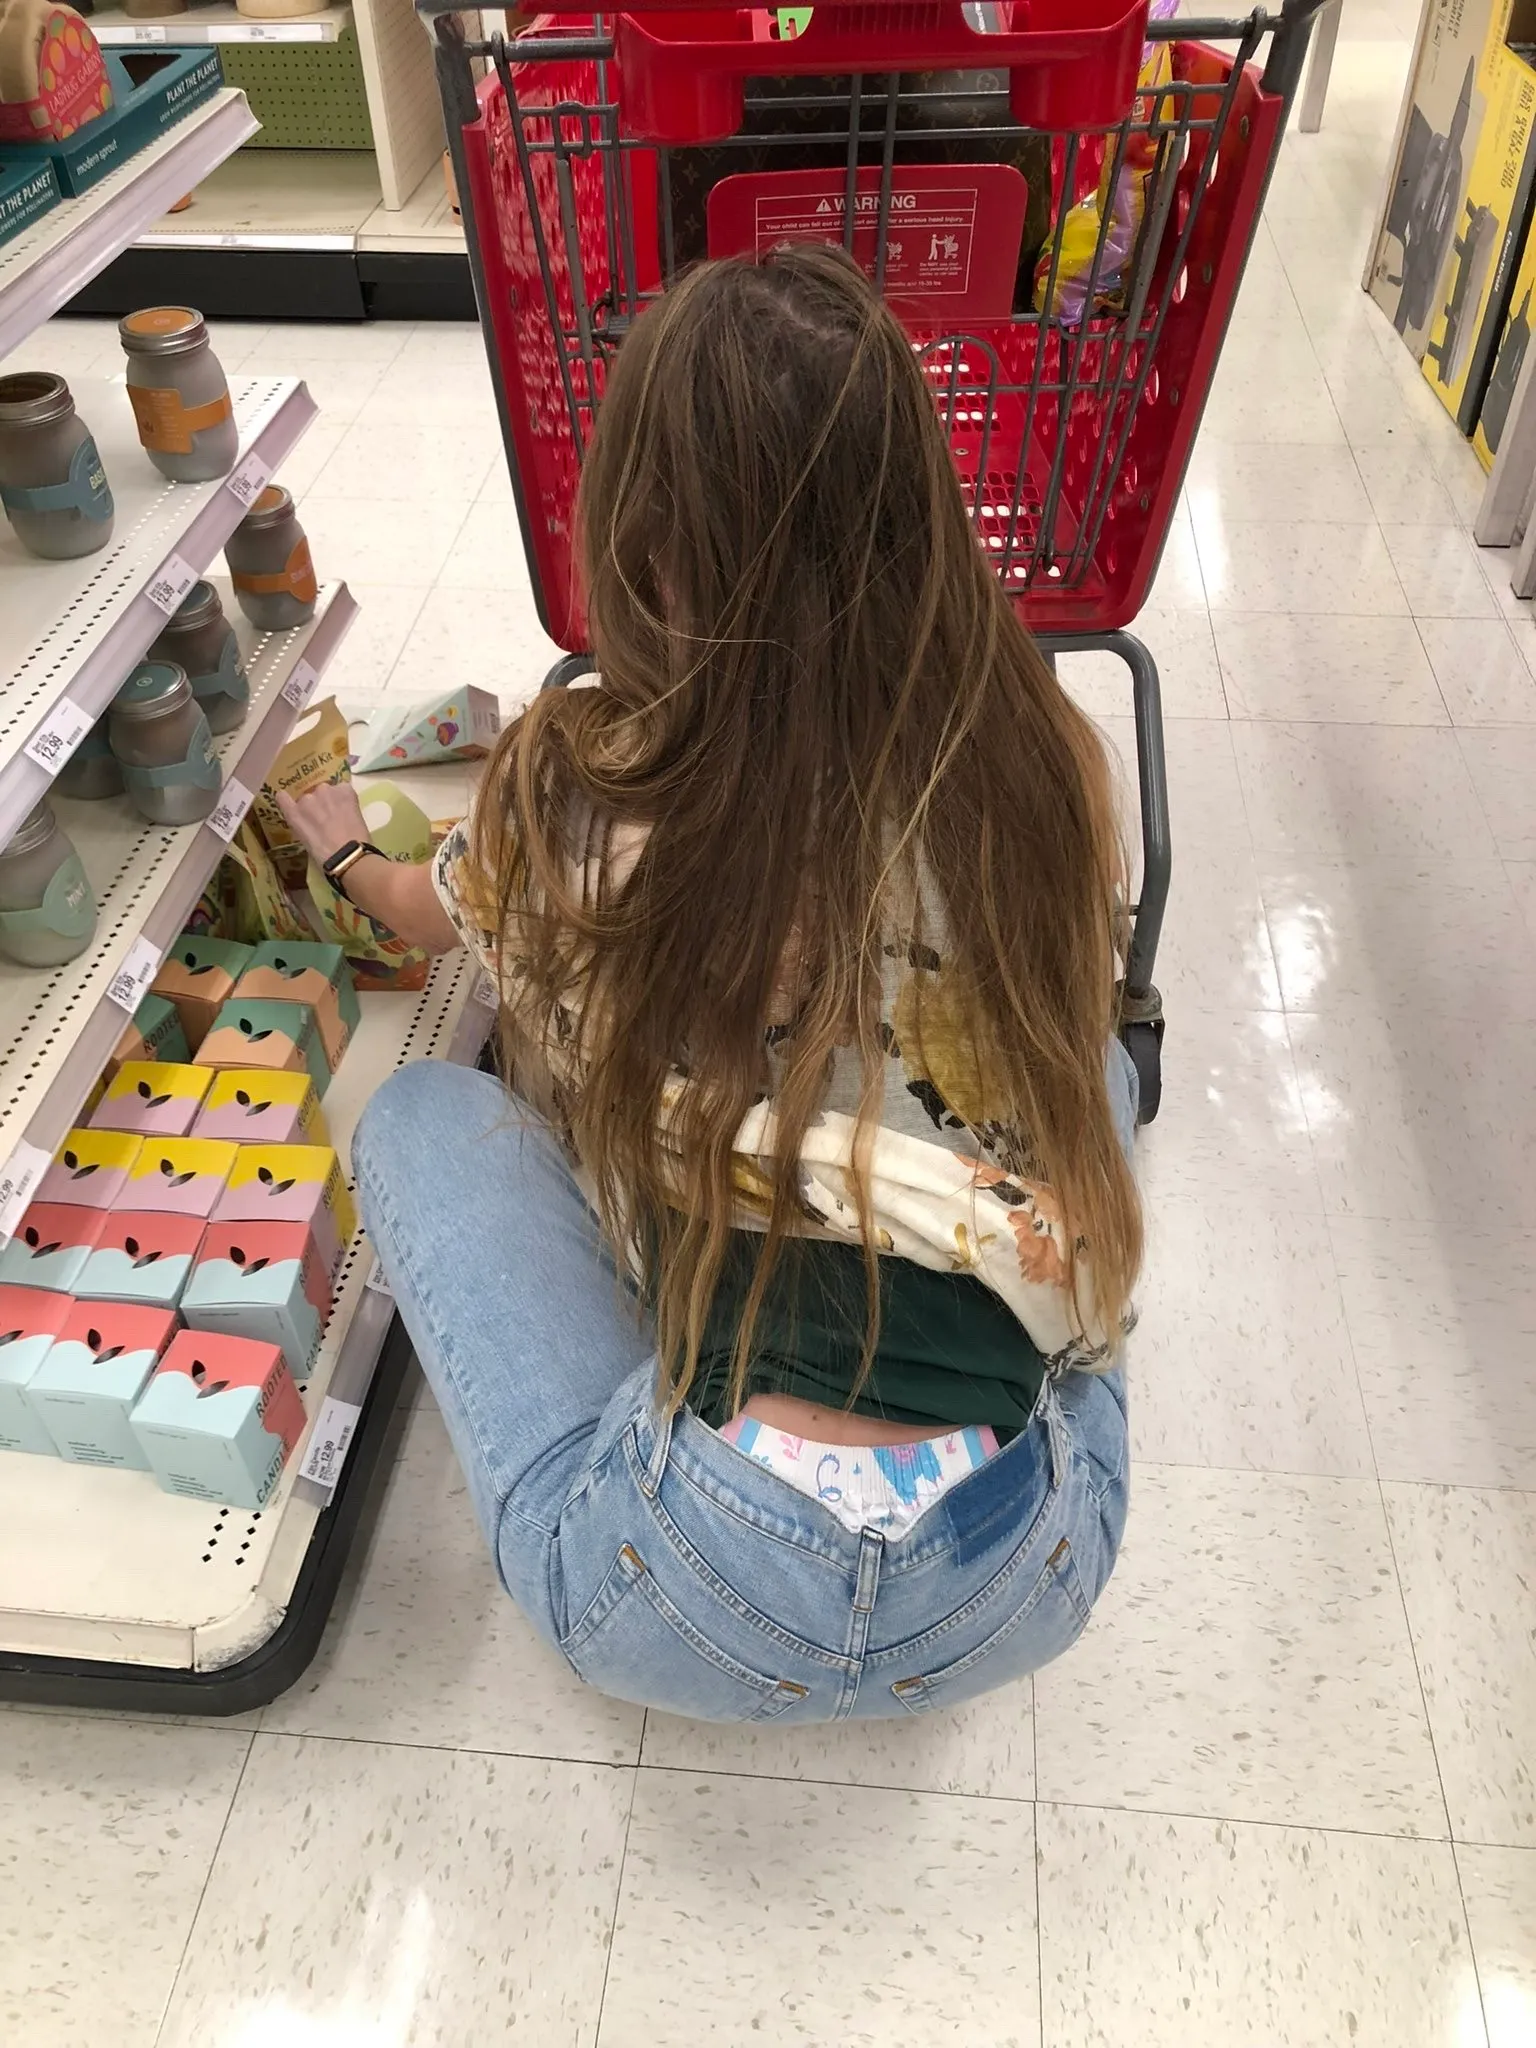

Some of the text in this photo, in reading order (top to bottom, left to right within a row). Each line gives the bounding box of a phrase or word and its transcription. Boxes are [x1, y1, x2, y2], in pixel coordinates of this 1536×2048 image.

[166, 81, 185, 104] PLANT
[184, 72, 197, 90] THE
[196, 57, 218, 81] PLANET
[76, 138, 118, 176] modern sprout
[6, 192, 23, 214] THE
[22, 171, 51, 203] PLANET
[157, 584, 176, 605] 12.99
[41, 735, 63, 761] 12.99
[278, 769, 302, 790] Seed
[300, 758, 319, 777] Ball
[318, 751, 334, 766] Kit
[394, 850, 411, 864] Kit
[117, 975, 136, 1001] 12.99
[255, 1354, 288, 1419] ROOTED
[321, 1440, 335, 1462] 12.99
[255, 1437, 290, 1504] CANDLE
